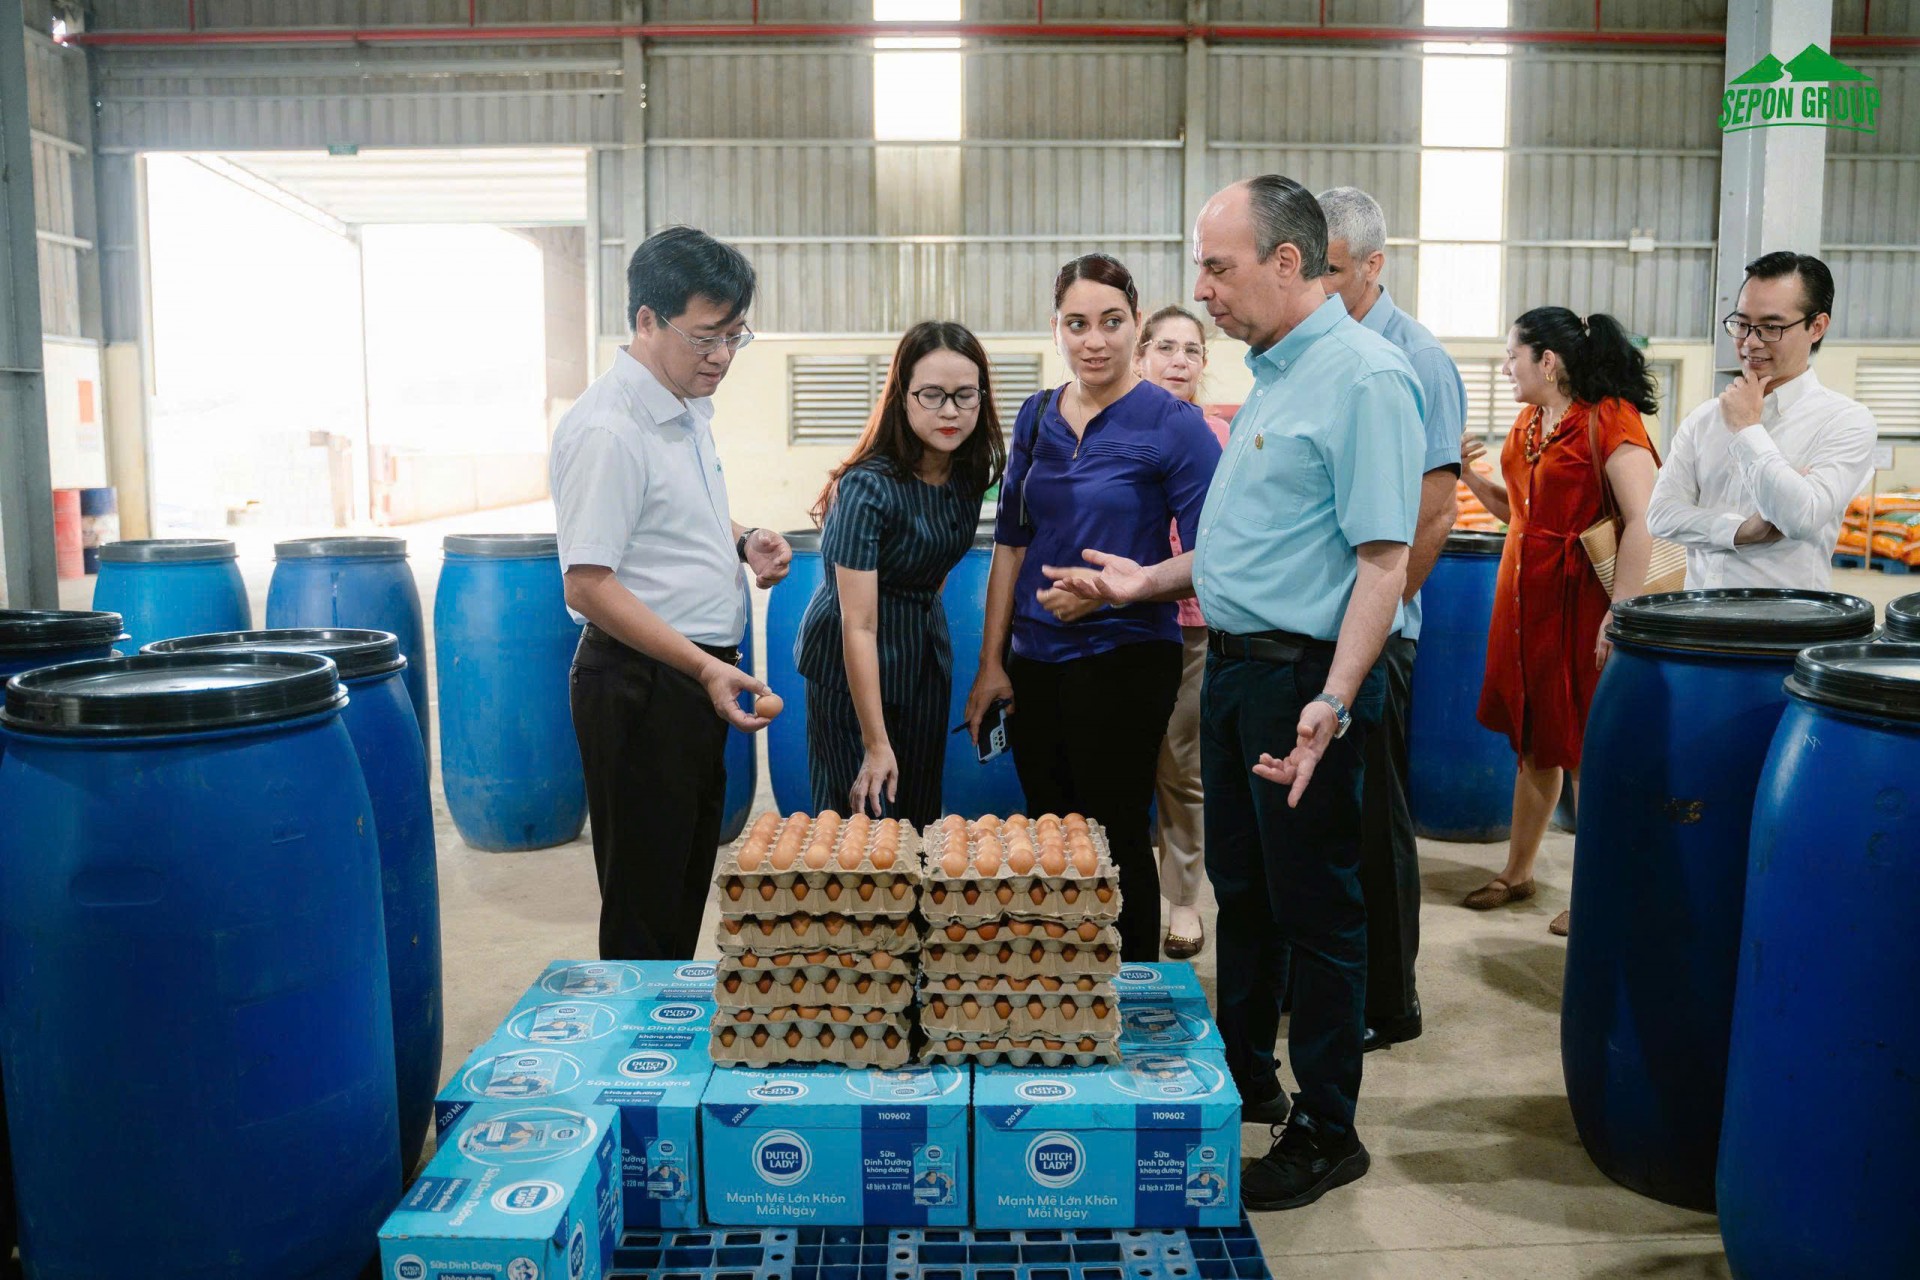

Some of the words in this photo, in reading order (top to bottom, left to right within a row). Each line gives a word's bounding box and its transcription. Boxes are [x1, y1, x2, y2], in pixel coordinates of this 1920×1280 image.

[440, 1111, 454, 1126] 220
[451, 1102, 464, 1115] ML
[731, 1112, 743, 1124] 220
[740, 1106, 750, 1116] ML
[878, 1112, 911, 1120] 1109602
[1005, 1115, 1017, 1126] 220
[1013, 1107, 1023, 1117] ML
[1152, 1112, 1185, 1120] 1109602
[765, 1151, 799, 1160] DUTCH
[880, 1150, 896, 1158] Sữa
[1039, 1152, 1073, 1161] DUTCH
[1153, 1150, 1170, 1158] Sữa
[770, 1160, 795, 1168] LADY
[884, 1158, 912, 1167] Dưỡng
[1043, 1161, 1069, 1170] LADY
[1137, 1159, 1157, 1167] Dinh
[1158, 1159, 1185, 1168] Dưỡng
[626, 1179, 637, 1187] 220
[637, 1179, 645, 1187] ml
[874, 1183, 886, 1191] bịch
[470, 1181, 492, 1201] Dinh
[1146, 1184, 1159, 1192] bịch
[726, 1192, 763, 1205] Mạnh
[765, 1192, 786, 1203] Mẽ
[788, 1192, 810, 1203] Lớn
[813, 1192, 846, 1204] Khôn
[998, 1195, 1035, 1208] Mạnh
[1037, 1195, 1057, 1206] Mẽ
[1060, 1195, 1082, 1206] Lớn
[1085, 1195, 1118, 1206] Khôn
[756, 1203, 780, 1215] Mỗi
[783, 1204, 817, 1217] Ngày
[1027, 1205, 1051, 1218] Mỗi
[1053, 1207, 1088, 1220] Ngày
[430, 1260, 448, 1269] Sữa
[449, 1261, 470, 1270] Dinh
[471, 1261, 503, 1272] Dưỡng
